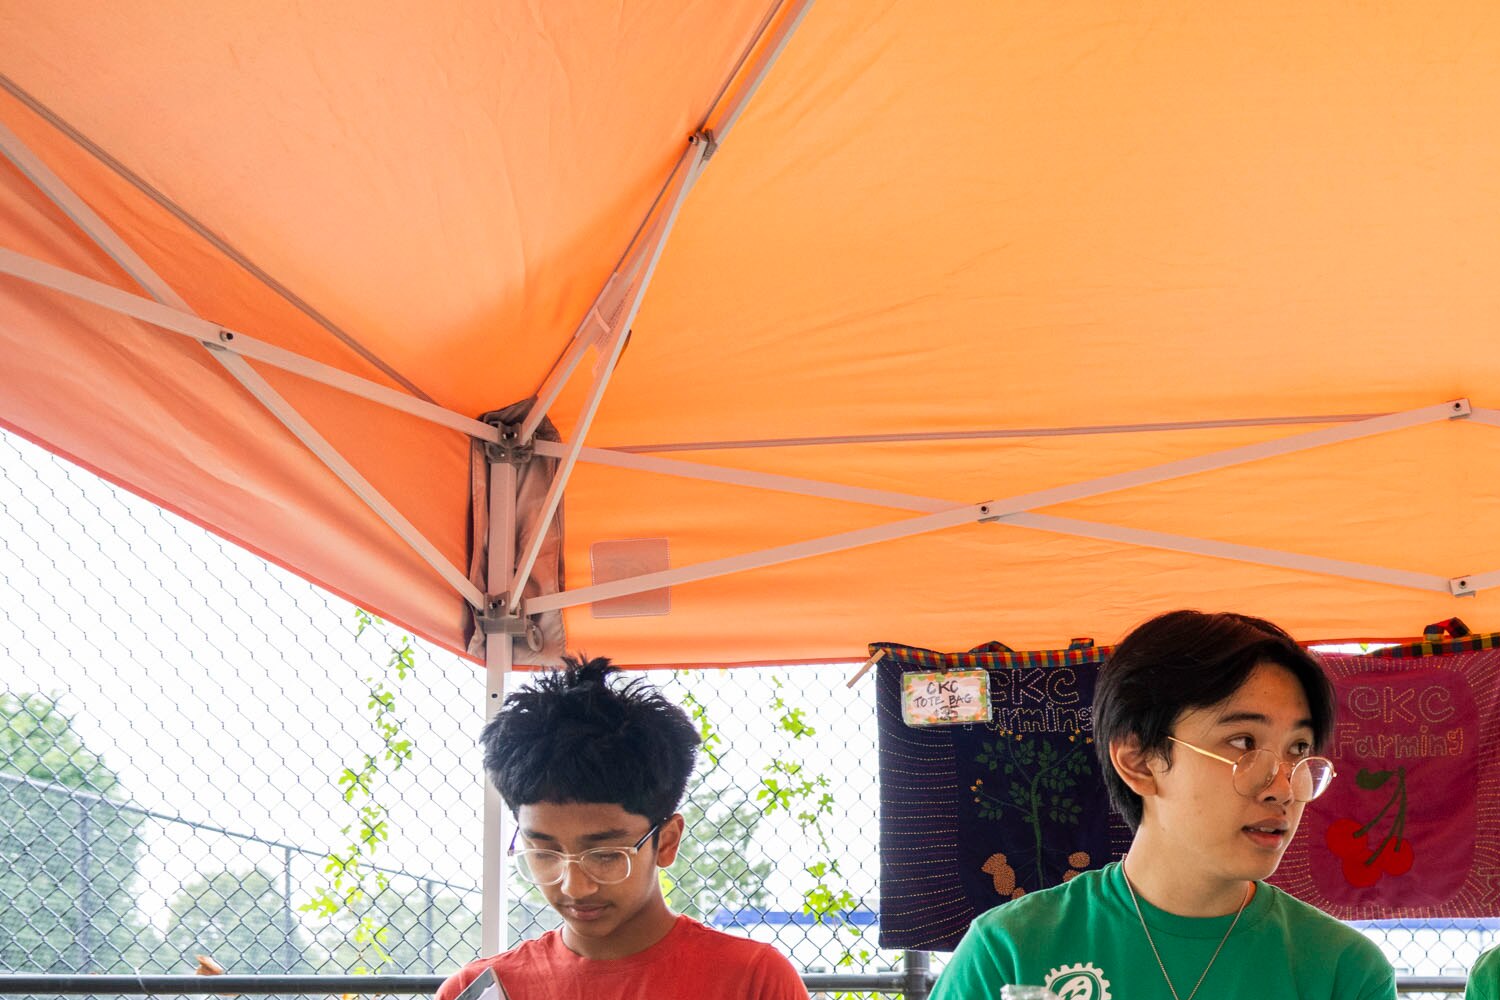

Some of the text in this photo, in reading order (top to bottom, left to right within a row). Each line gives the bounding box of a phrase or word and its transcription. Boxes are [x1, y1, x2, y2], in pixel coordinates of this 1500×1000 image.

[926, 680, 959, 695] CKC
[913, 693, 973, 709] TOTE BAG
[1333, 723, 1465, 760] Farming
